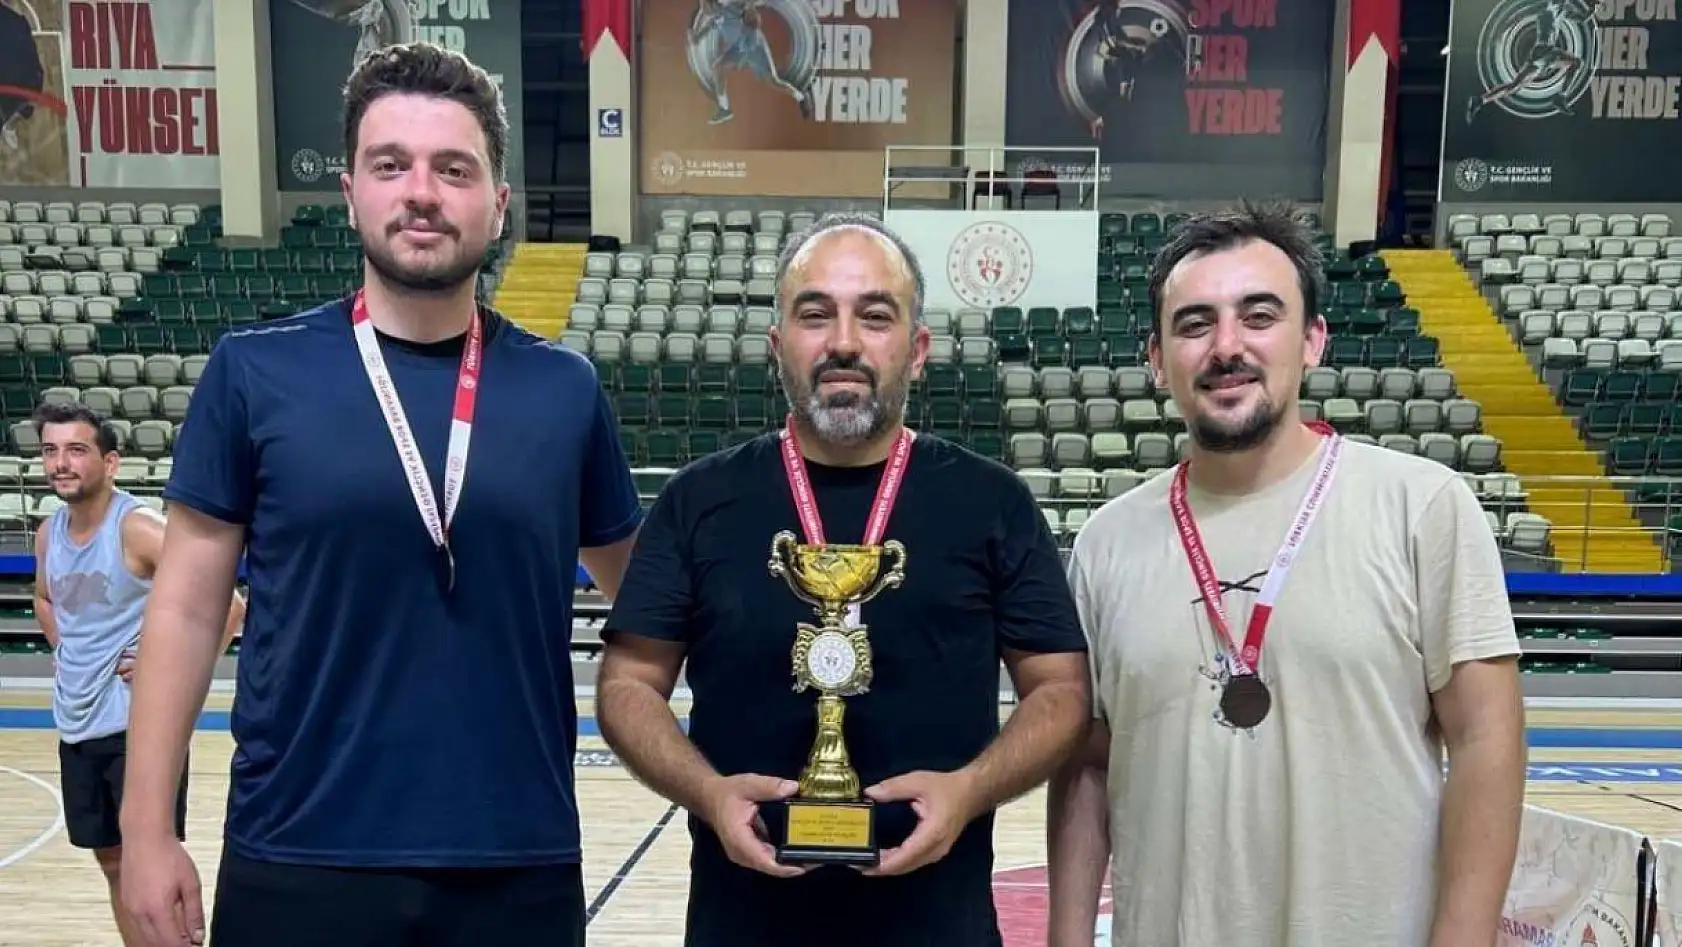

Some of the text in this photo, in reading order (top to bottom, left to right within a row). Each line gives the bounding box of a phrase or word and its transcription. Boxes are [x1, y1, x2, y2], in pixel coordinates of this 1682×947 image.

[812, 24, 872, 70] HER
[1591, 26, 1650, 70] HER
[811, 76, 909, 124] YERDE
[1184, 87, 1285, 135] YERDE
[1590, 75, 1682, 118] YERDE
[602, 111, 620, 128] C
